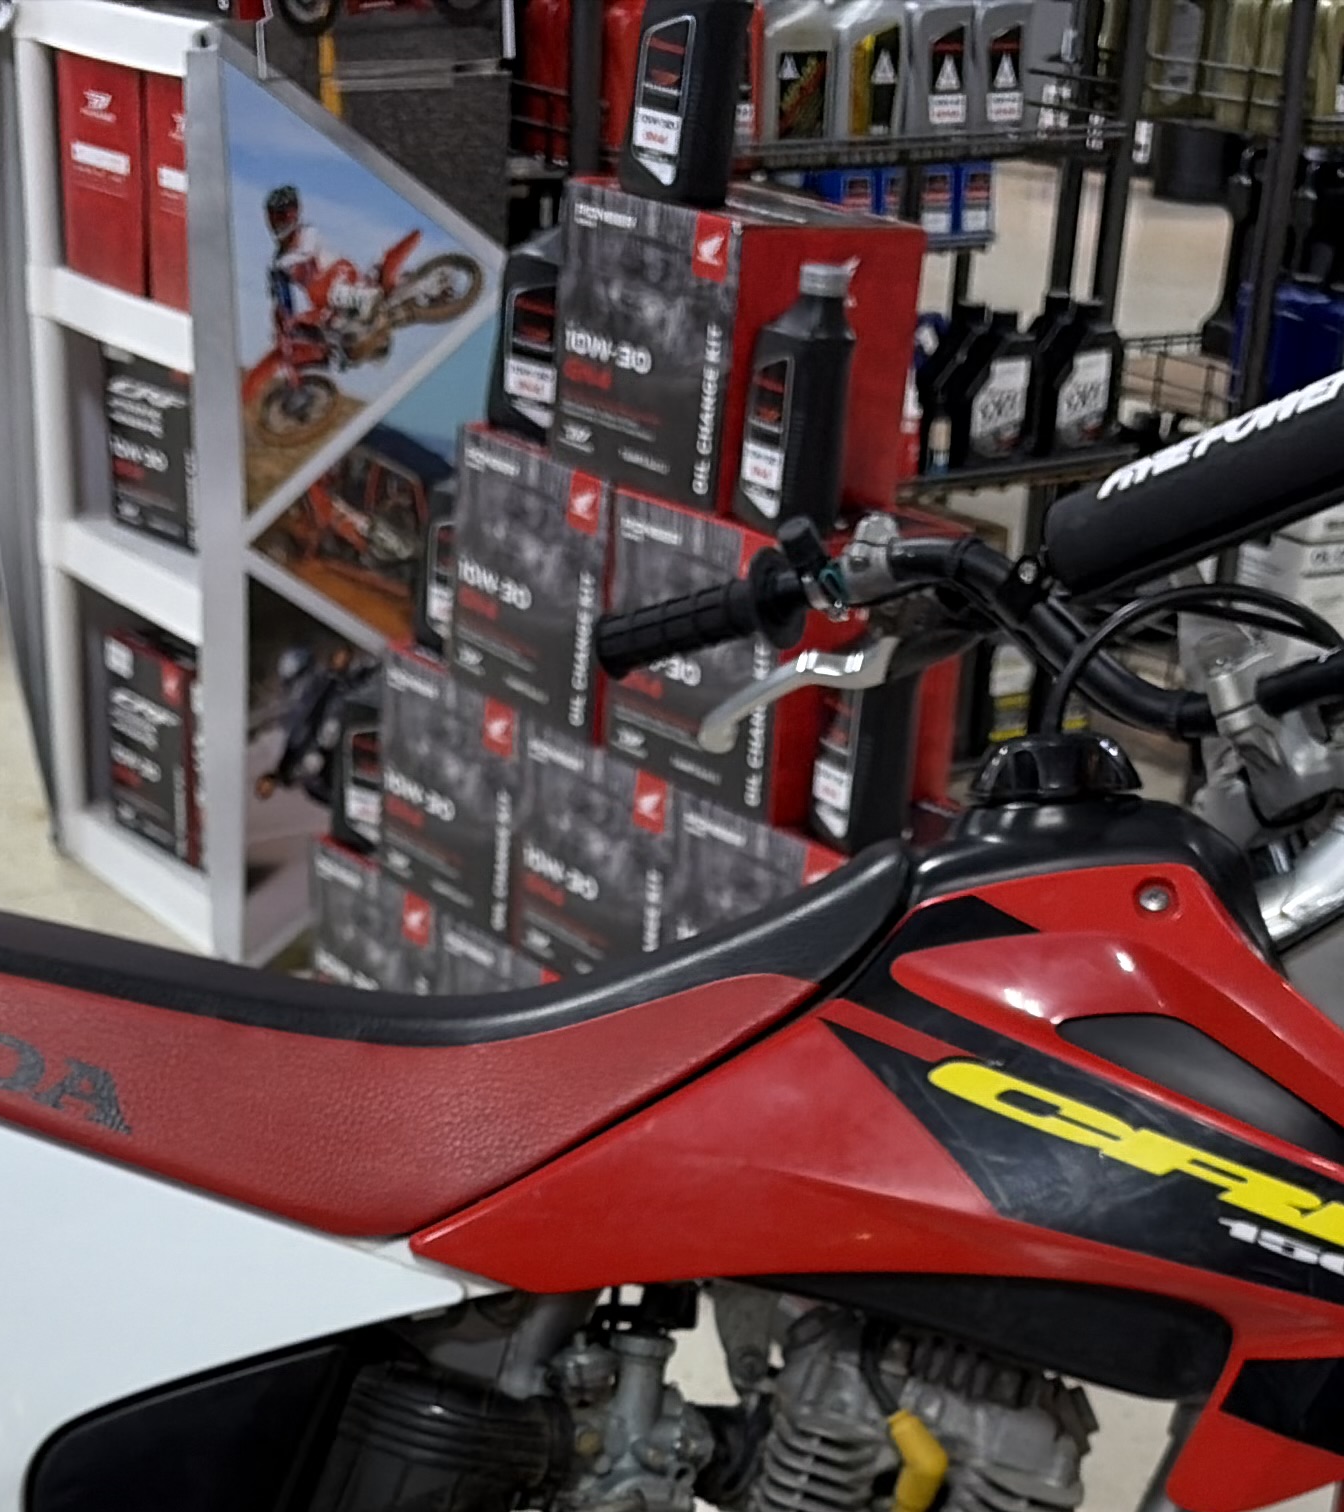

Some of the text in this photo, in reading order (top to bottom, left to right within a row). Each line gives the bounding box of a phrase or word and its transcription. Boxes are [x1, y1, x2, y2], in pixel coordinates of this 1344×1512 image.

[565, 324, 652, 374] 10W-30
[696, 366, 720, 456] CHANGE
[692, 459, 711, 495] OIL
